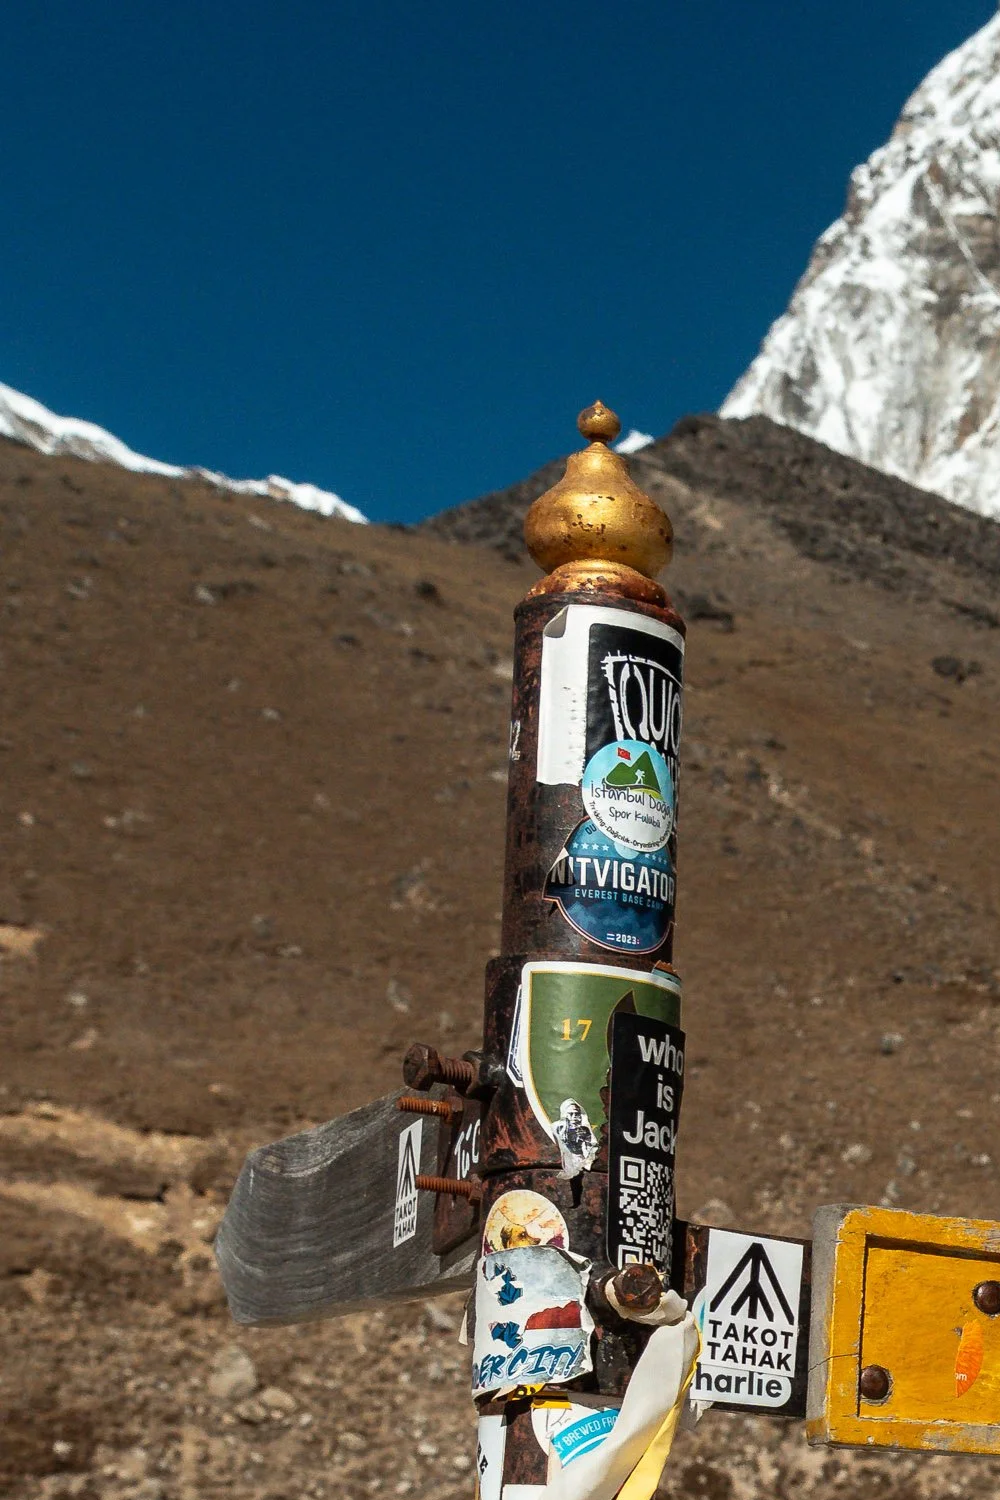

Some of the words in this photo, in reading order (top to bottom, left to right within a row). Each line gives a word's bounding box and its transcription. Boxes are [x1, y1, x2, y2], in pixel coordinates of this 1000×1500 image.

[609, 807, 632, 821] Spor
[575, 888, 618, 901] EVEREST
[623, 893, 645, 906] BASE
[616, 933, 637, 945] 2023
[560, 1018, 592, 1041] 17
[638, 1034, 684, 1077] who
[657, 1074, 674, 1112] is
[396, 1197, 416, 1222] TAKOT
[394, 1217, 415, 1239] TAHAK
[709, 1320, 793, 1349] TAKOT
[507, 1341, 584, 1379] CITY
[707, 1342, 792, 1372] TAHAK
[693, 1364, 783, 1398] harlie
[562, 1420, 601, 1446] BREWED
